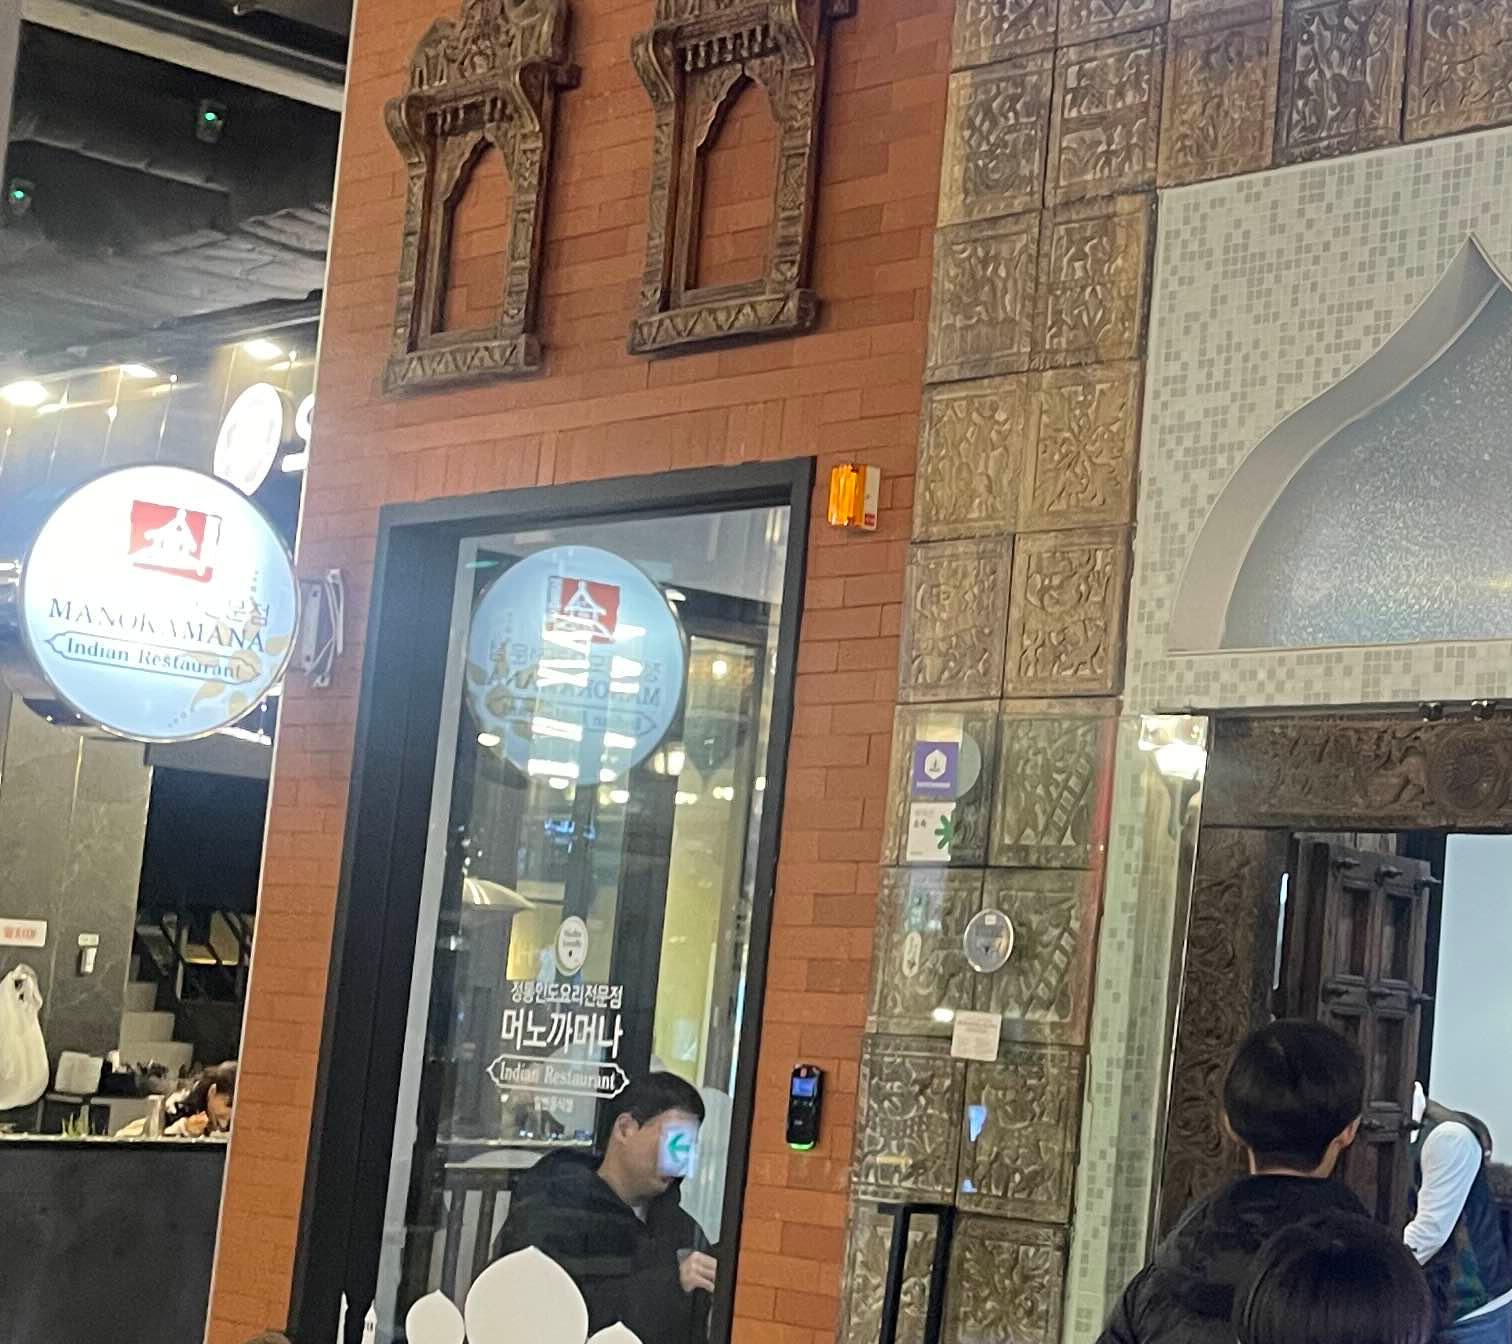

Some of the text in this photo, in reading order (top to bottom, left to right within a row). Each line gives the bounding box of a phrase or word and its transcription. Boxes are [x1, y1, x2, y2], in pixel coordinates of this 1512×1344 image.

[66, 637, 243, 680] Indian Restaurant
[501, 1007, 623, 1059] 머노까머나
[500, 1061, 540, 1084] Indian
